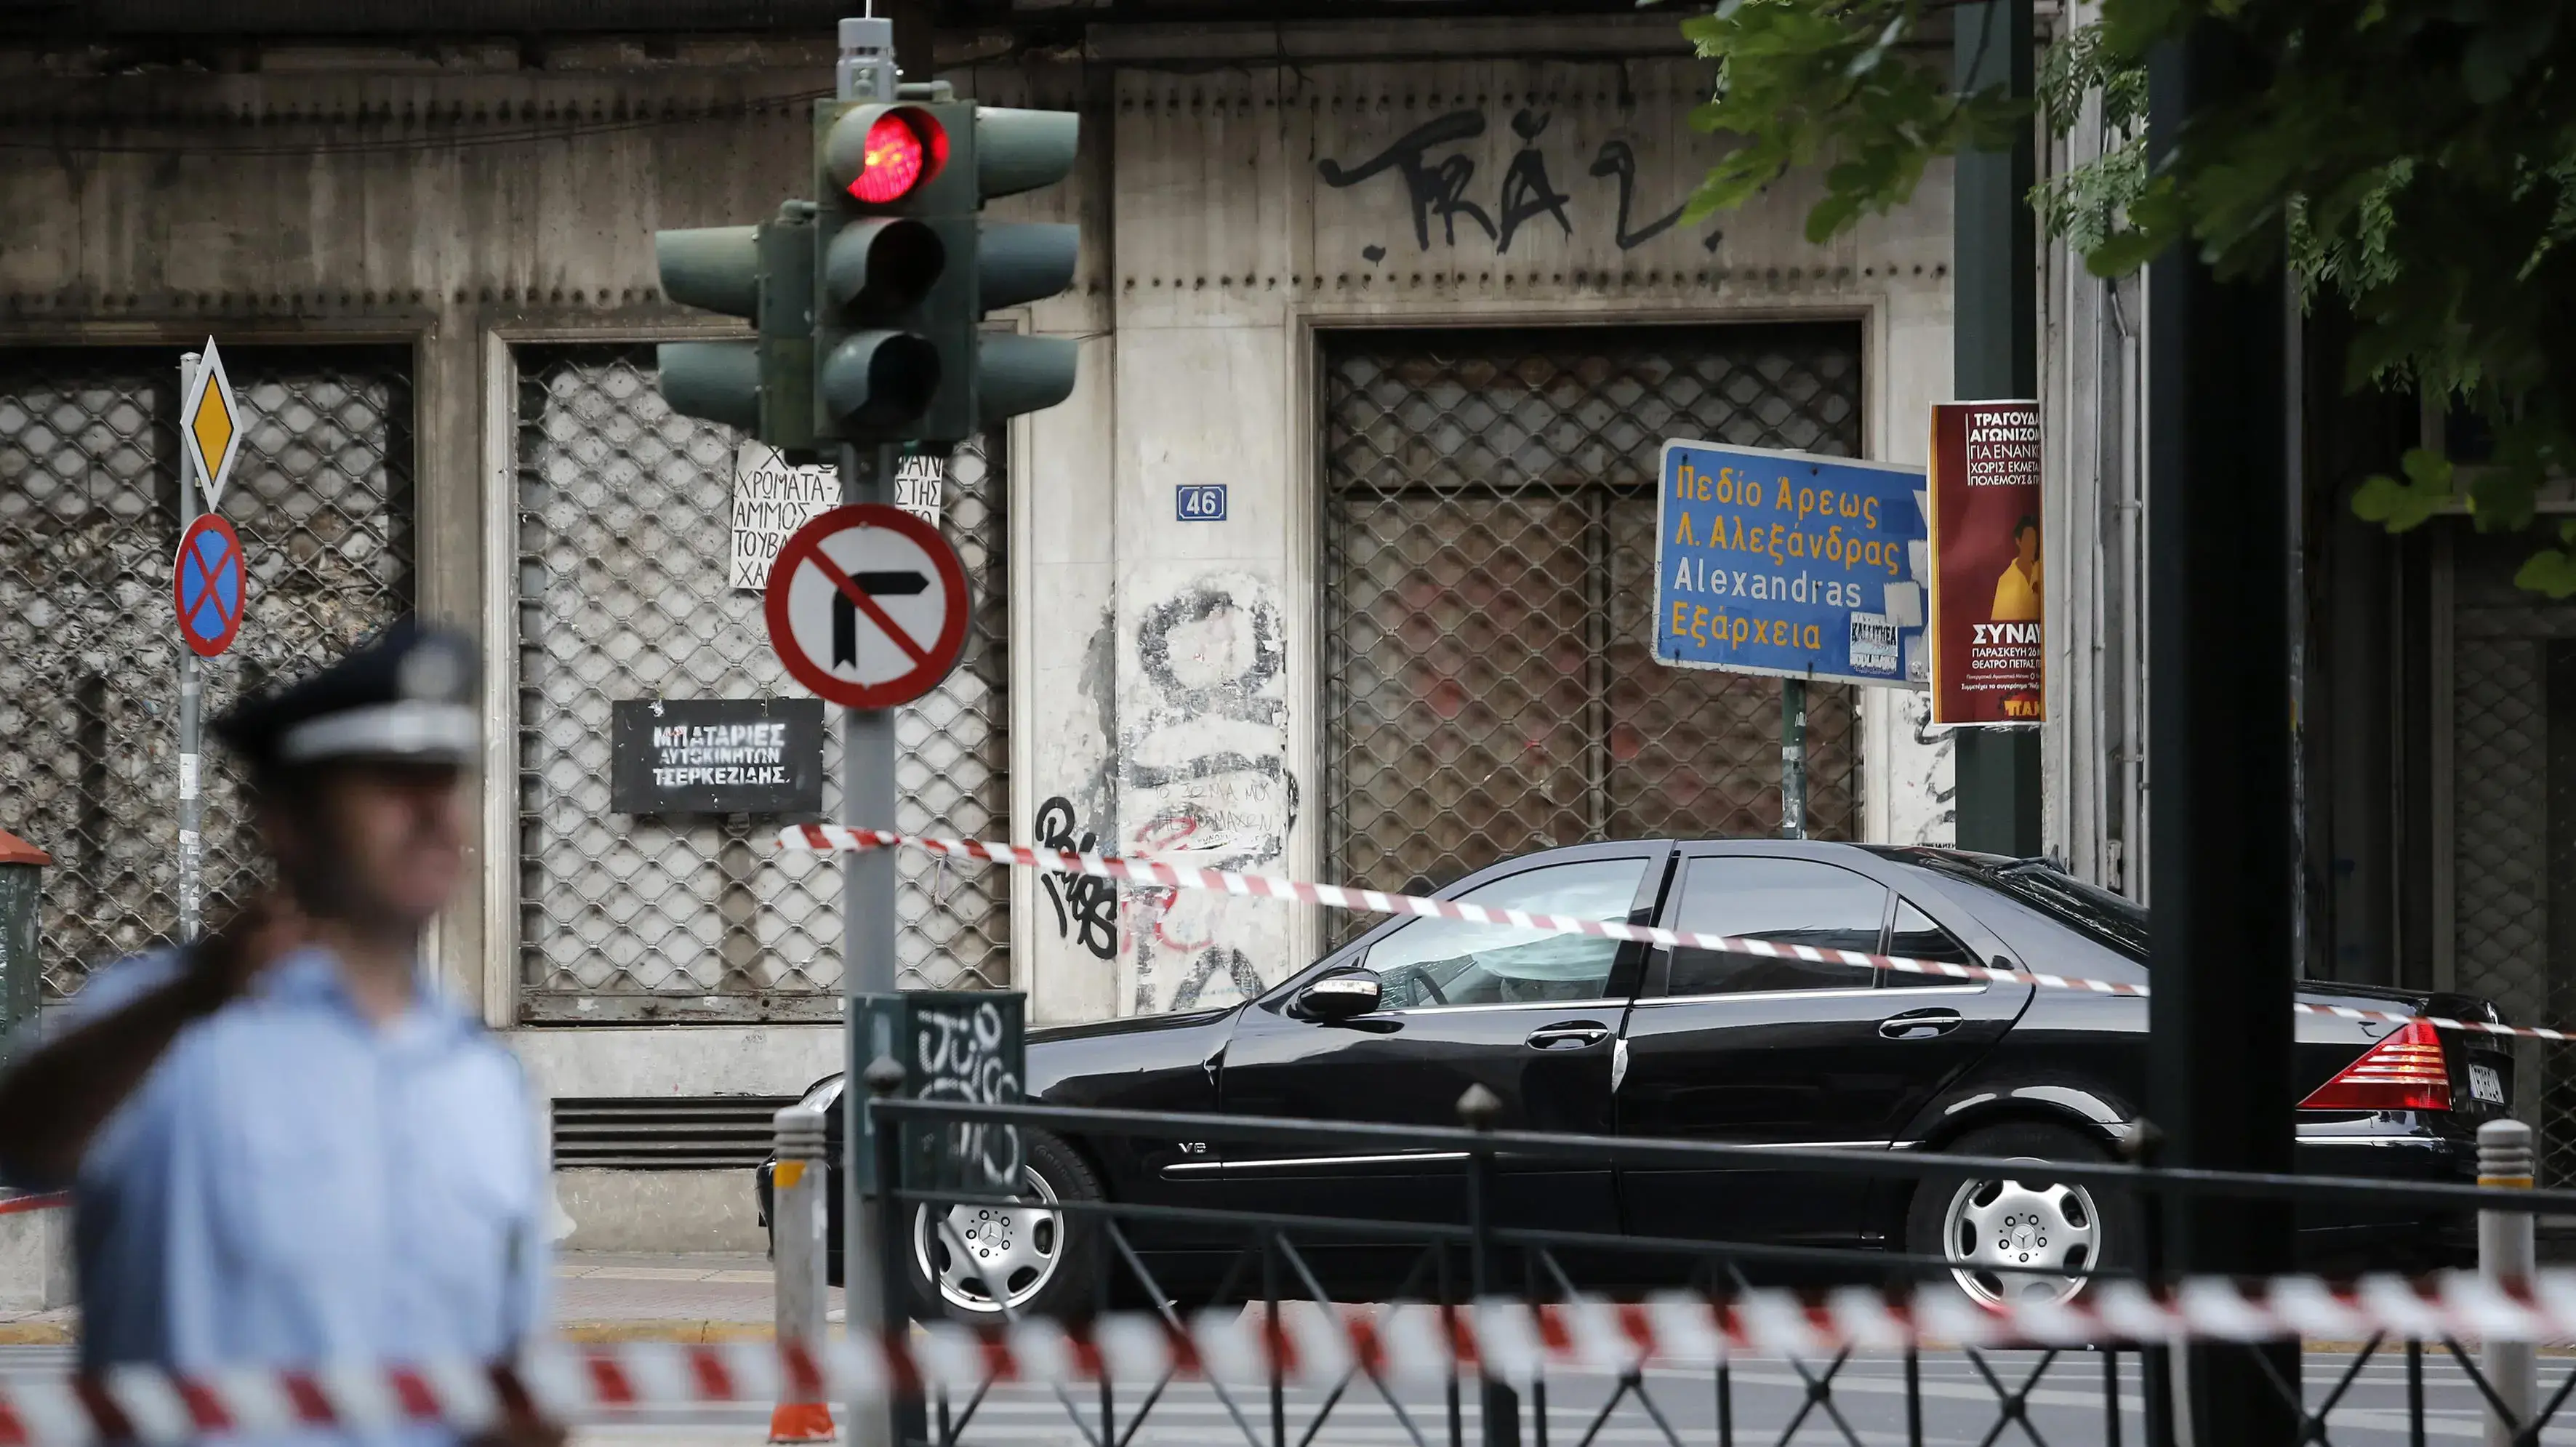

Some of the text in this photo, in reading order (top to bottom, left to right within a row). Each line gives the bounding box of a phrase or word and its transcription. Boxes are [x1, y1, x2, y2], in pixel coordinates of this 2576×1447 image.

[1970, 444, 1992, 460] ΓΙΑ
[1994, 444, 2031, 459] ΕΝΑΝ
[1970, 462, 2005, 473] ΧΩΡΙΣ
[1970, 474, 2026, 486] ΠΟΛΕΜΟΥΣ
[895, 478, 941, 507] ΣΤΗΣ
[1677, 465, 1762, 508] Πεδίο
[1186, 490, 1216, 515] 46
[1676, 512, 1900, 575] Λ. Αλεξάνδρας
[1674, 556, 1861, 608] Alexandras
[1672, 601, 1821, 649] Εξάρχεια
[1972, 647, 2026, 658] ΠΑΡΑΣΚΕΥΗ
[2028, 647, 2037, 657] 26
[1972, 660, 2007, 669] ΘΕΑΤΡΟ
[654, 723, 786, 748] ΜΠΑΤΑΡΙΕΣ
[659, 747, 781, 764] ΑΥΤΟΚΙΝΗΤΩΝ
